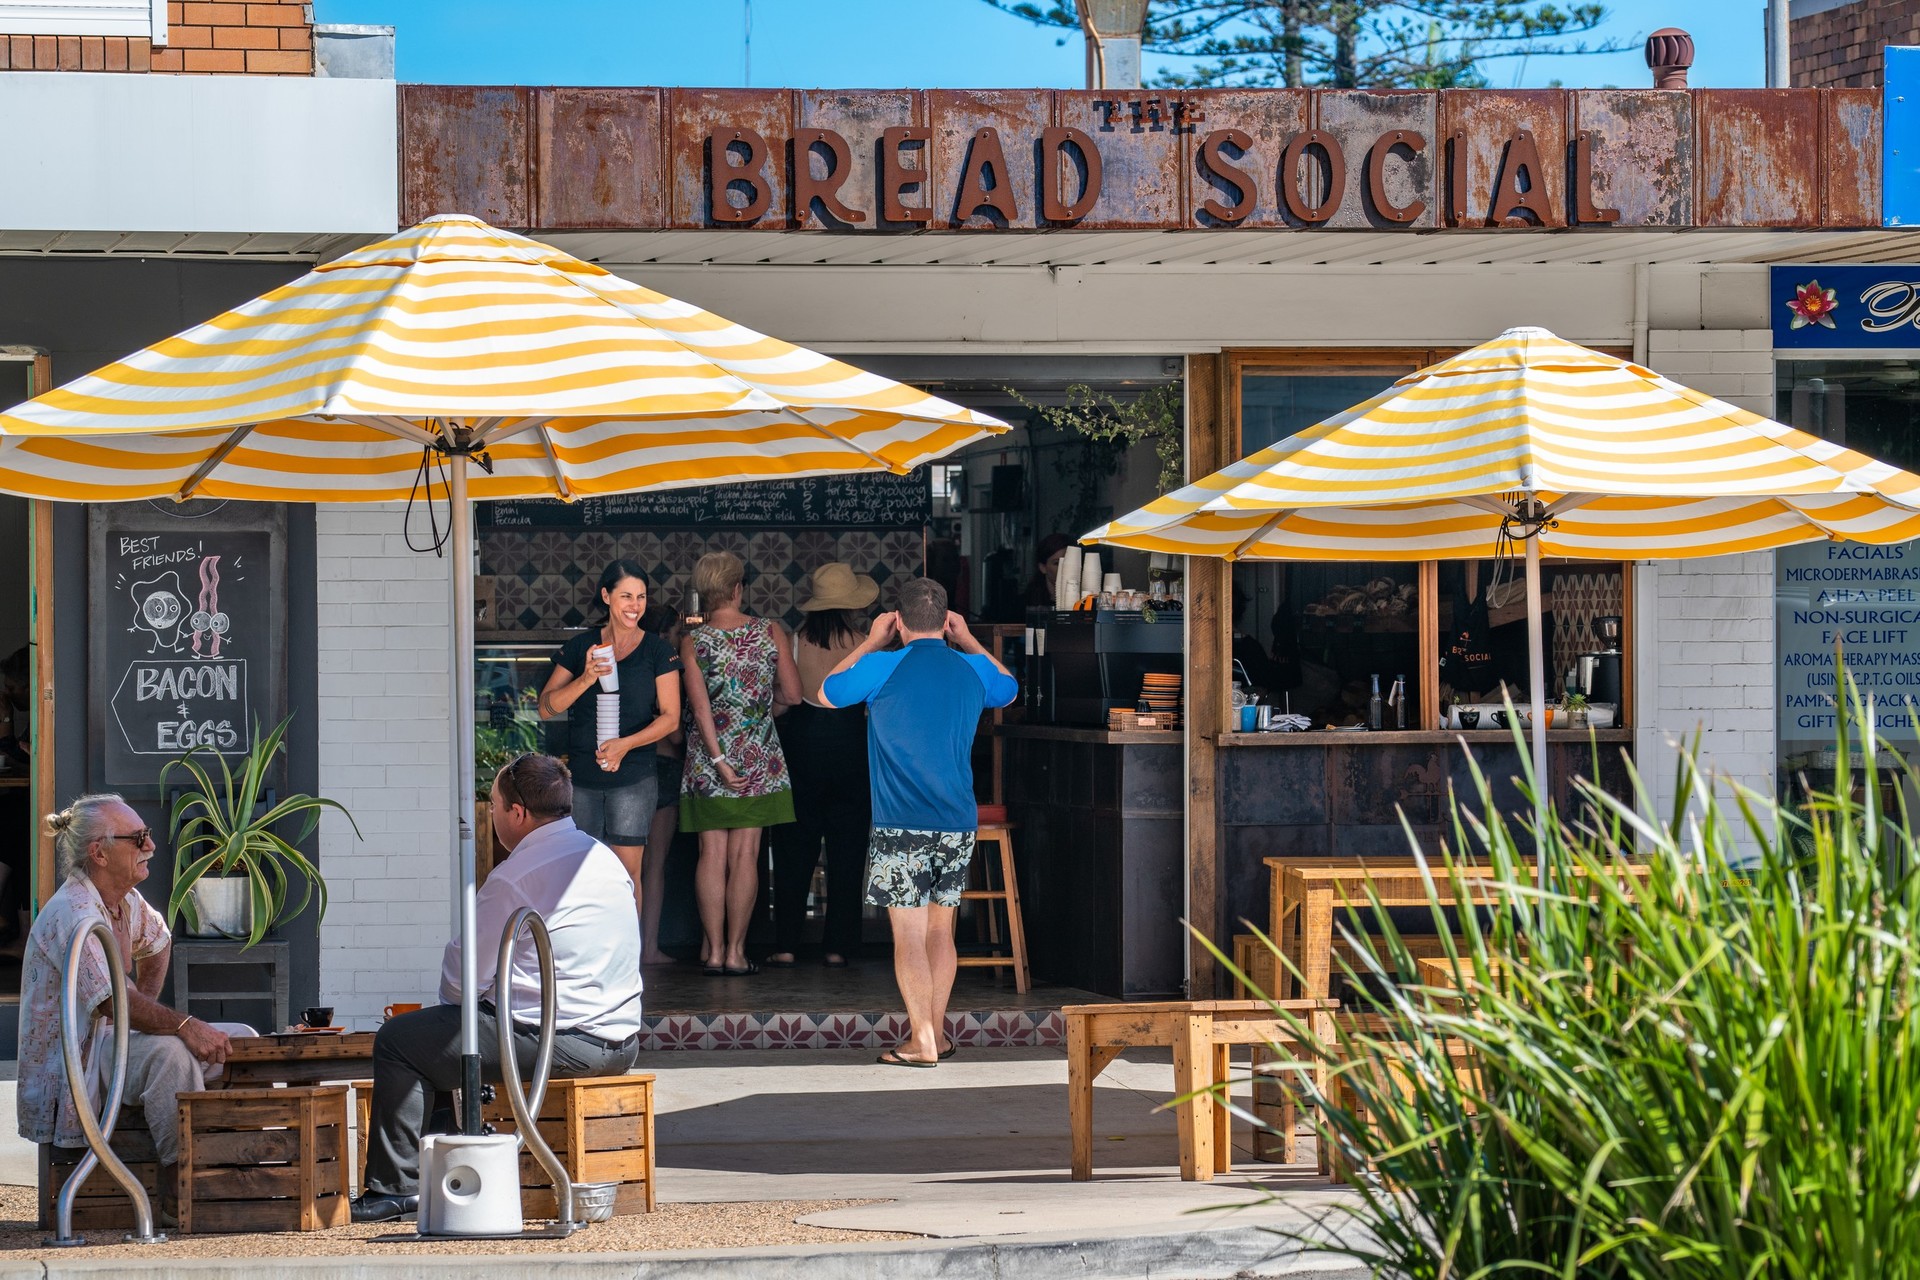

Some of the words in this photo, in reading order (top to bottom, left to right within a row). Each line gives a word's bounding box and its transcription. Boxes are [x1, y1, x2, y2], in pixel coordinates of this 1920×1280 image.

[1094, 92, 1206, 134] THE
[709, 127, 1101, 223] BREAD
[1199, 128, 1621, 226] SOCIAL
[120, 536, 161, 556] BEST
[132, 540, 203, 570] FRIENDS!
[1828, 546, 1904, 560] FACIALS
[1878, 589, 1917, 602] PEEL
[1822, 630, 1869, 644] FACE
[1873, 630, 1908, 644] LIFT
[137, 665, 238, 701] BACON
[1797, 714, 1836, 728] GIFT
[157, 720, 238, 749] EGGS
